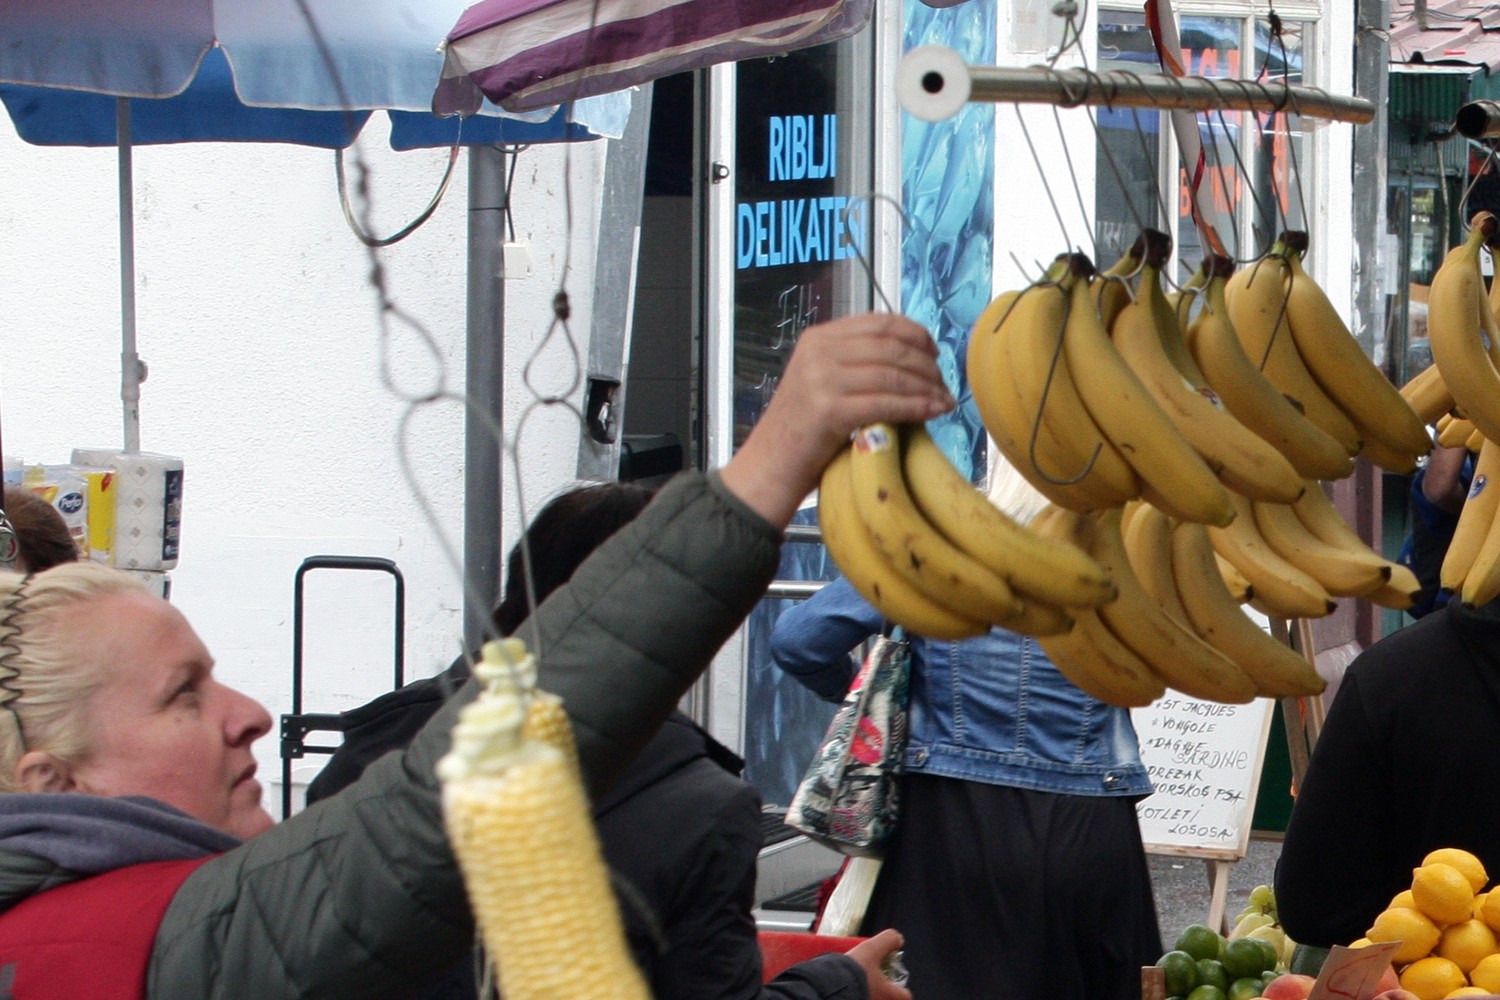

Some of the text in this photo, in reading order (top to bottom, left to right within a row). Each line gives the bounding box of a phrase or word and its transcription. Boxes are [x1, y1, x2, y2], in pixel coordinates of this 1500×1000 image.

[769, 114, 838, 182] RIBLJI
[1182, 702, 1237, 717] JACQUES
[1147, 765, 1203, 781] DREZAK
[1168, 823, 1233, 841] LOSOSA
